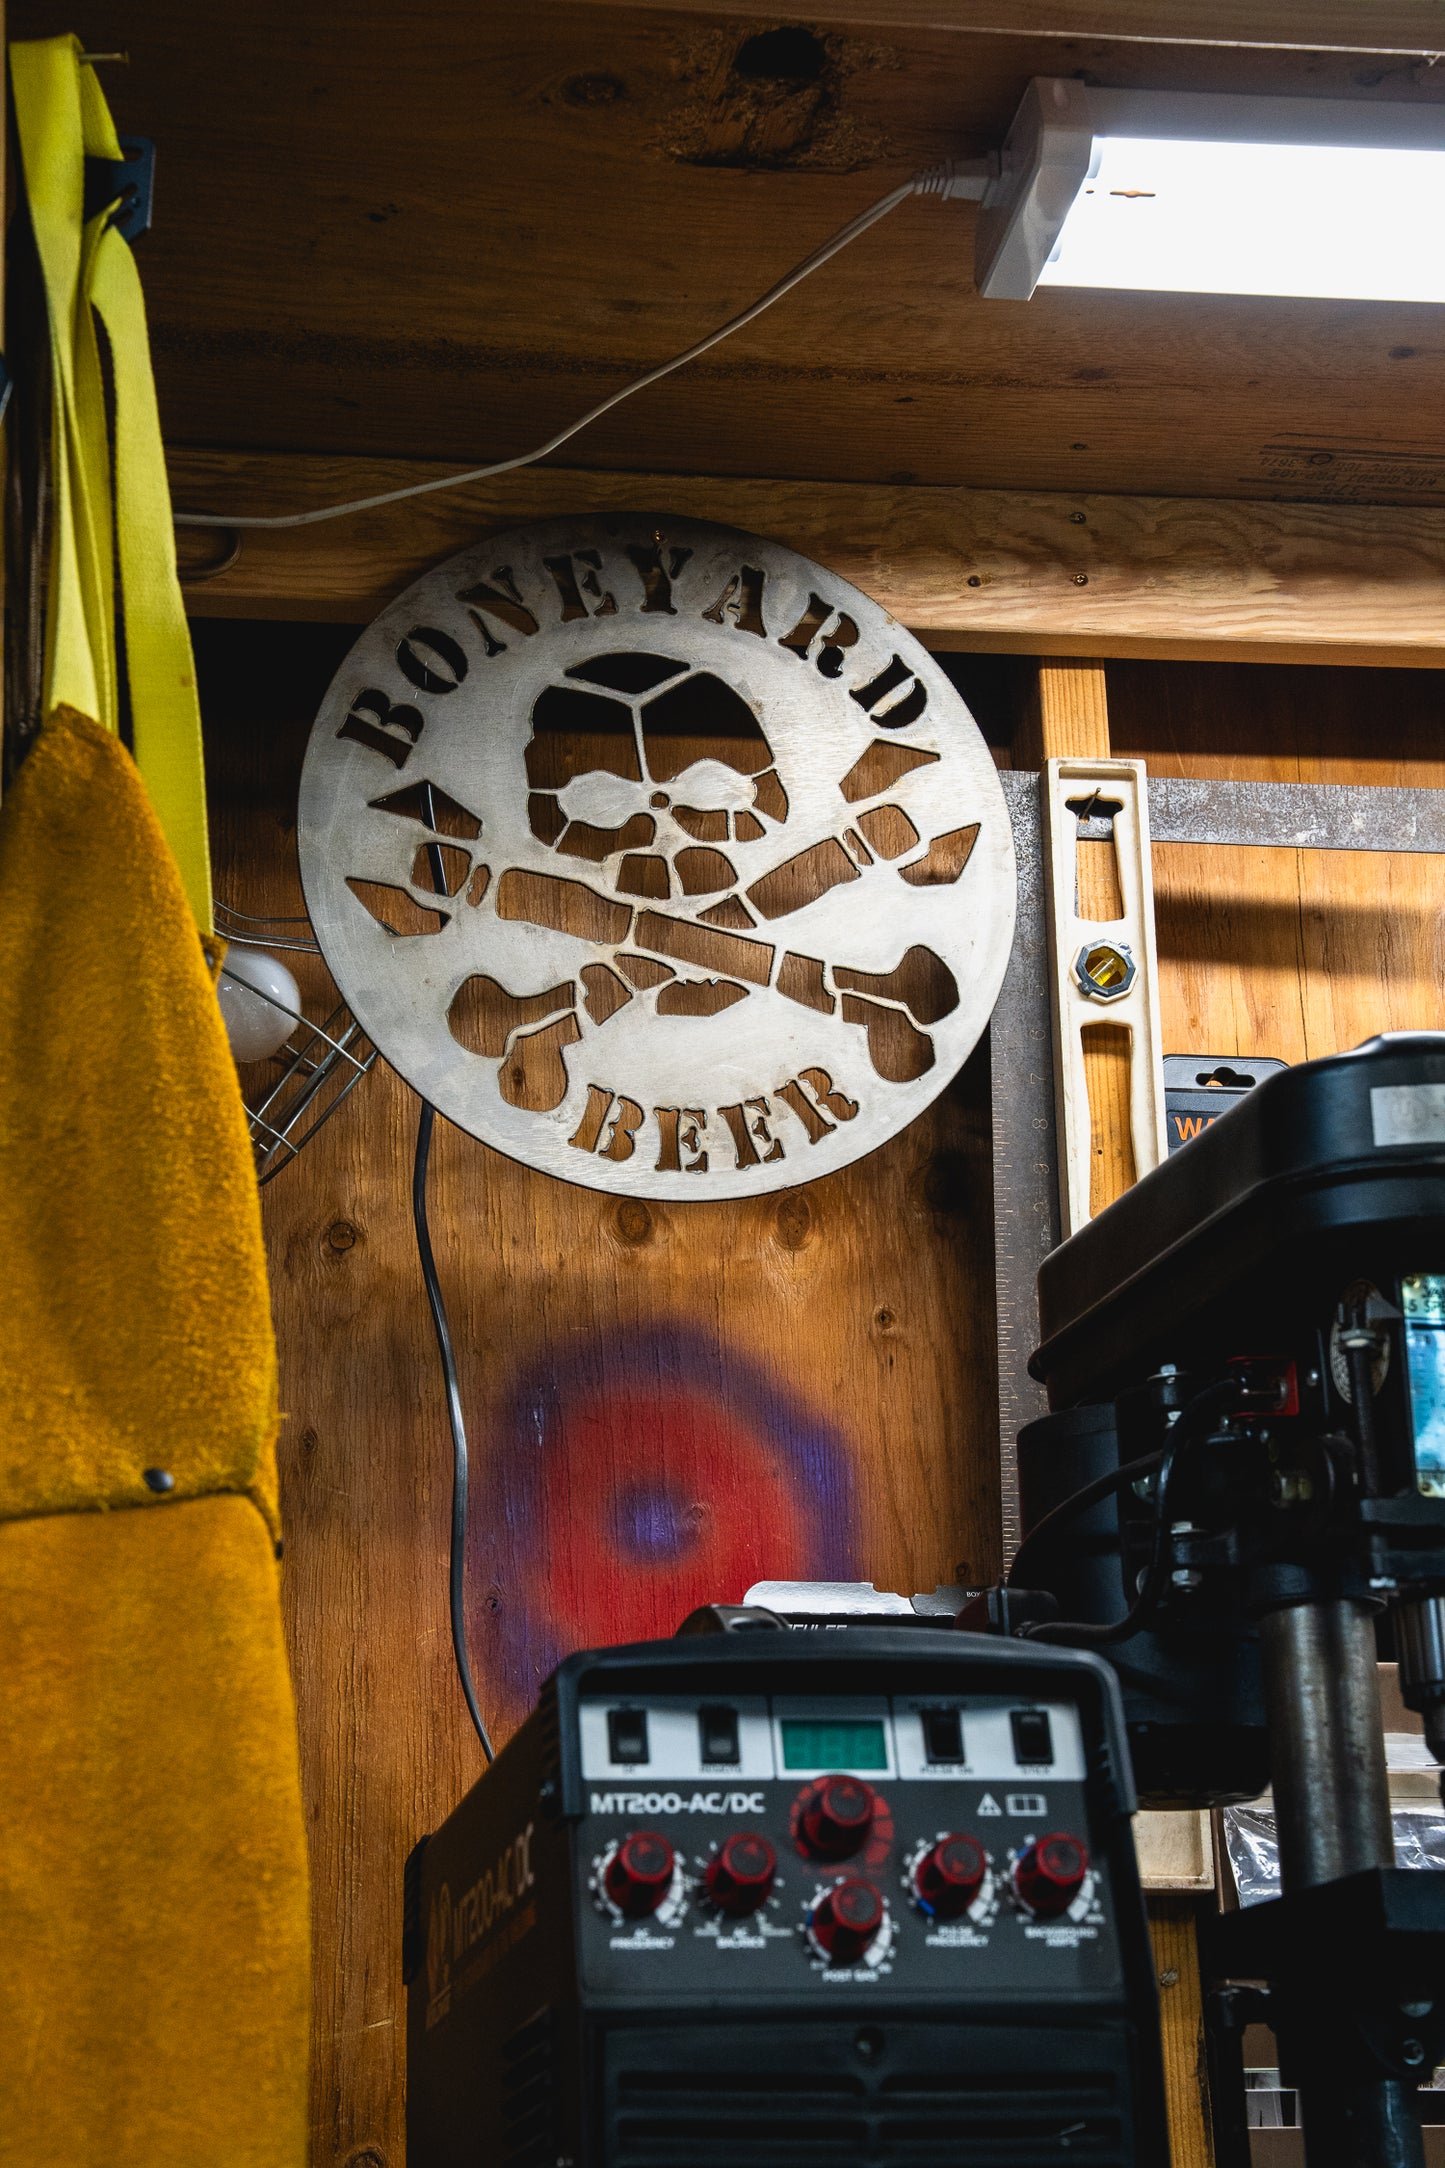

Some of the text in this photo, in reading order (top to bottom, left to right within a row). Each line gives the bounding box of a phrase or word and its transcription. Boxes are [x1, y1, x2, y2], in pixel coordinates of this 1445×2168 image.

[336, 545, 929, 769] BONEYARD
[567, 1066, 860, 1174] BEER
[590, 1792, 766, 1815] MT200-AC/DC
